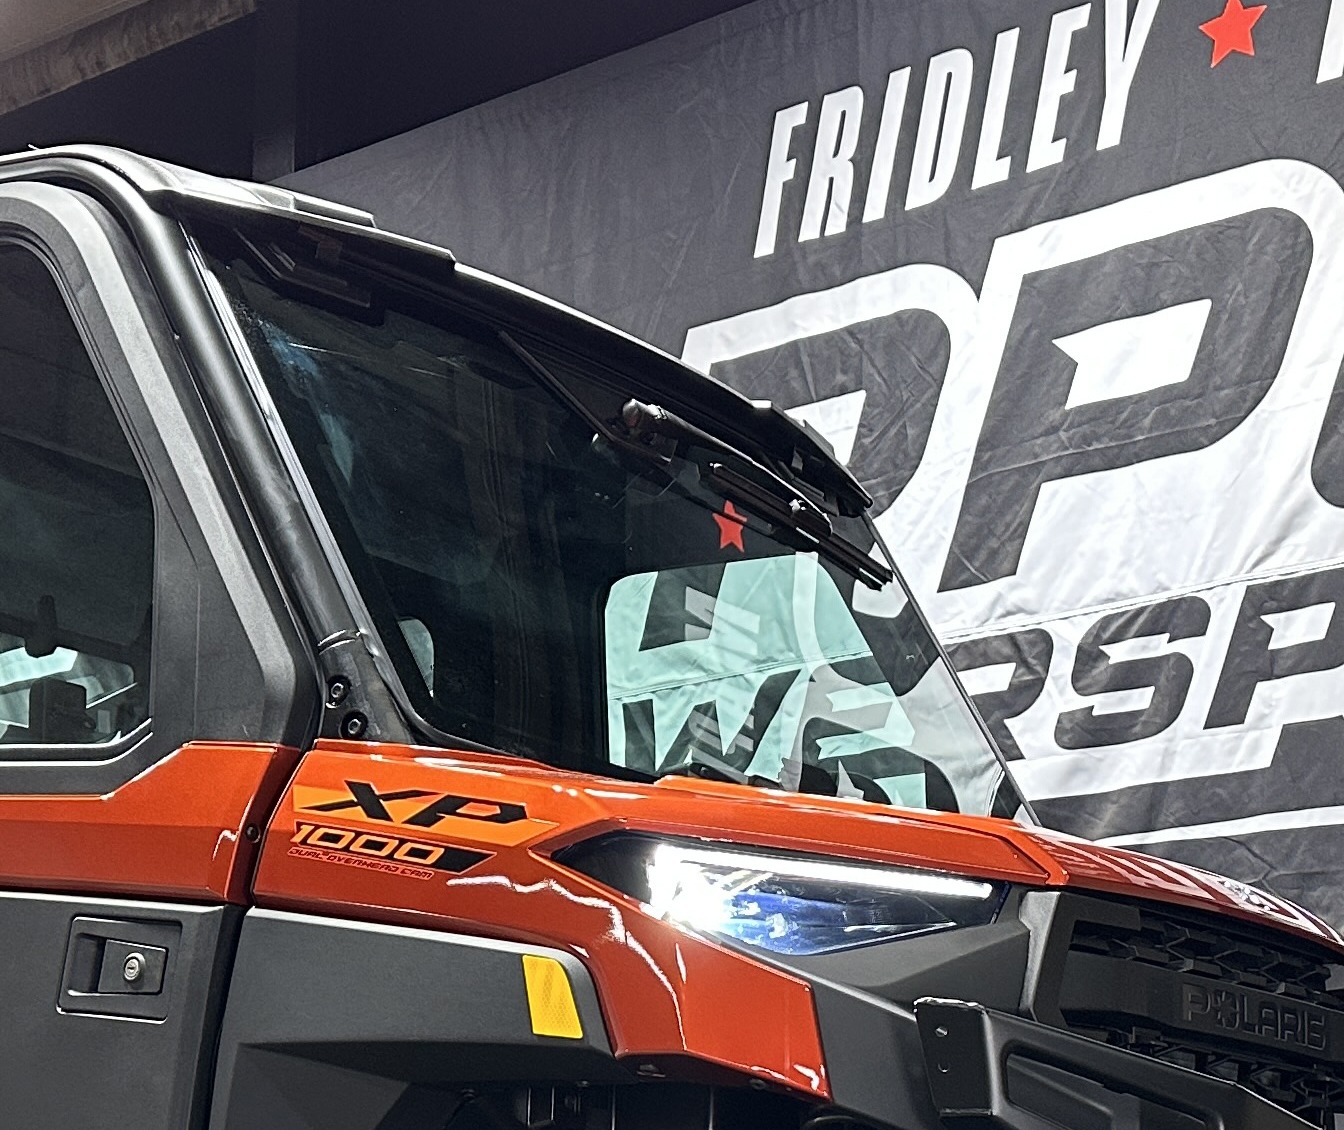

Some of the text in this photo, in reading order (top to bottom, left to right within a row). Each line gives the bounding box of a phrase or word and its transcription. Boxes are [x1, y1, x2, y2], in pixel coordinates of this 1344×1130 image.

[753, 0, 1162, 259] FRIDLEY
[299, 779, 528, 828] XP
[290, 825, 445, 865] 1000
[326, 854, 400, 873] OVERHEAD
[400, 867, 434, 880] CAM
[1182, 982, 1328, 1051] POLARIS
